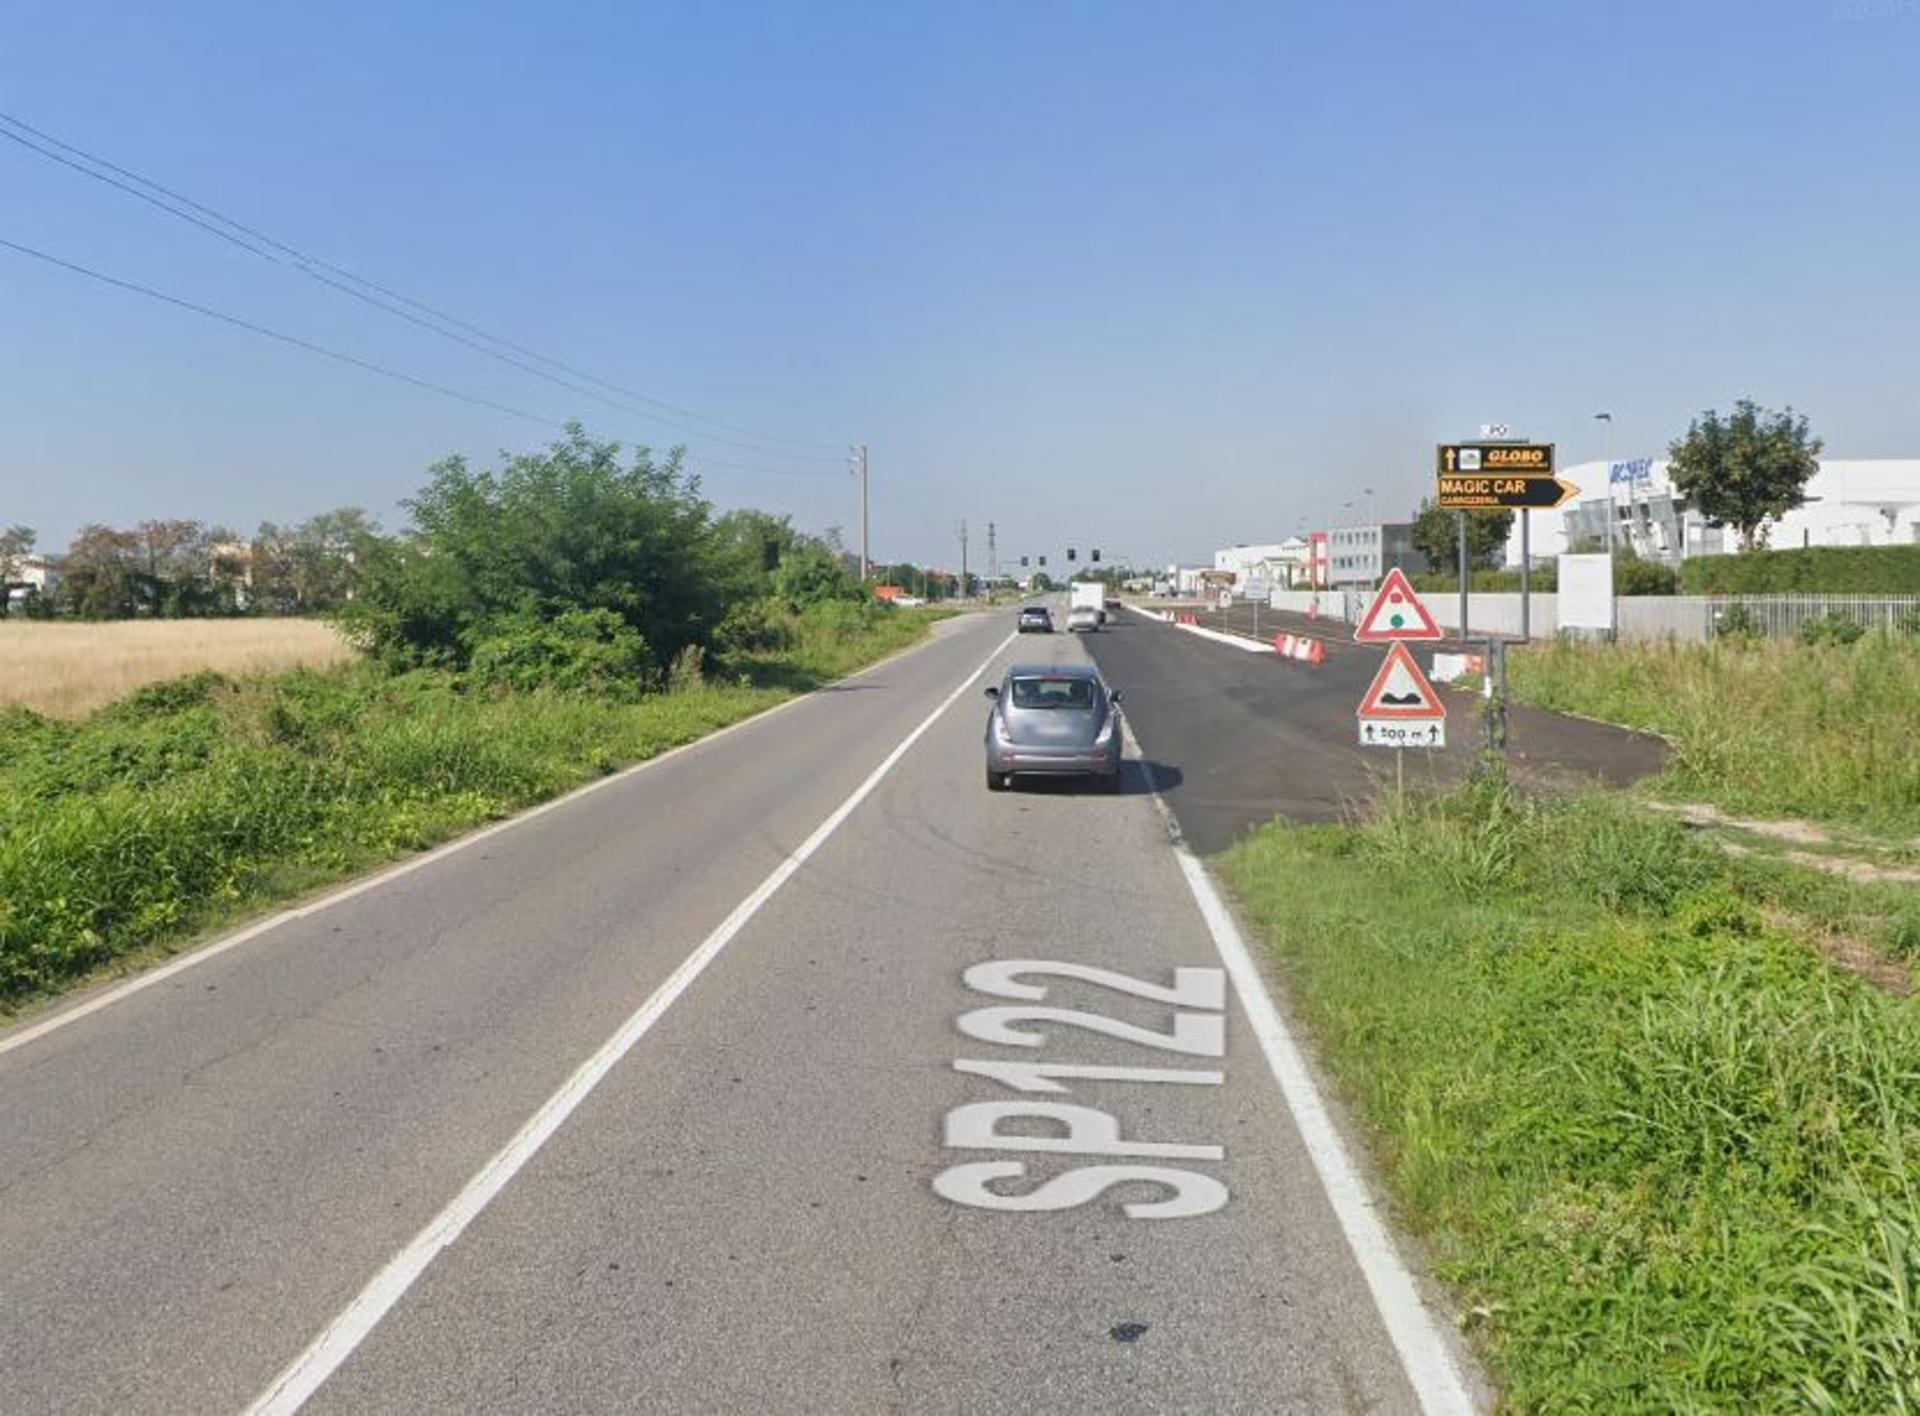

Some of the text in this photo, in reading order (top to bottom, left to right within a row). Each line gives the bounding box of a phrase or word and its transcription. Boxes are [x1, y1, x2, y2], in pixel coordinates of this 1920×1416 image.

[1488, 451, 1543, 462] GLOBO
[1441, 480, 1525, 493] MAGIC CAR
